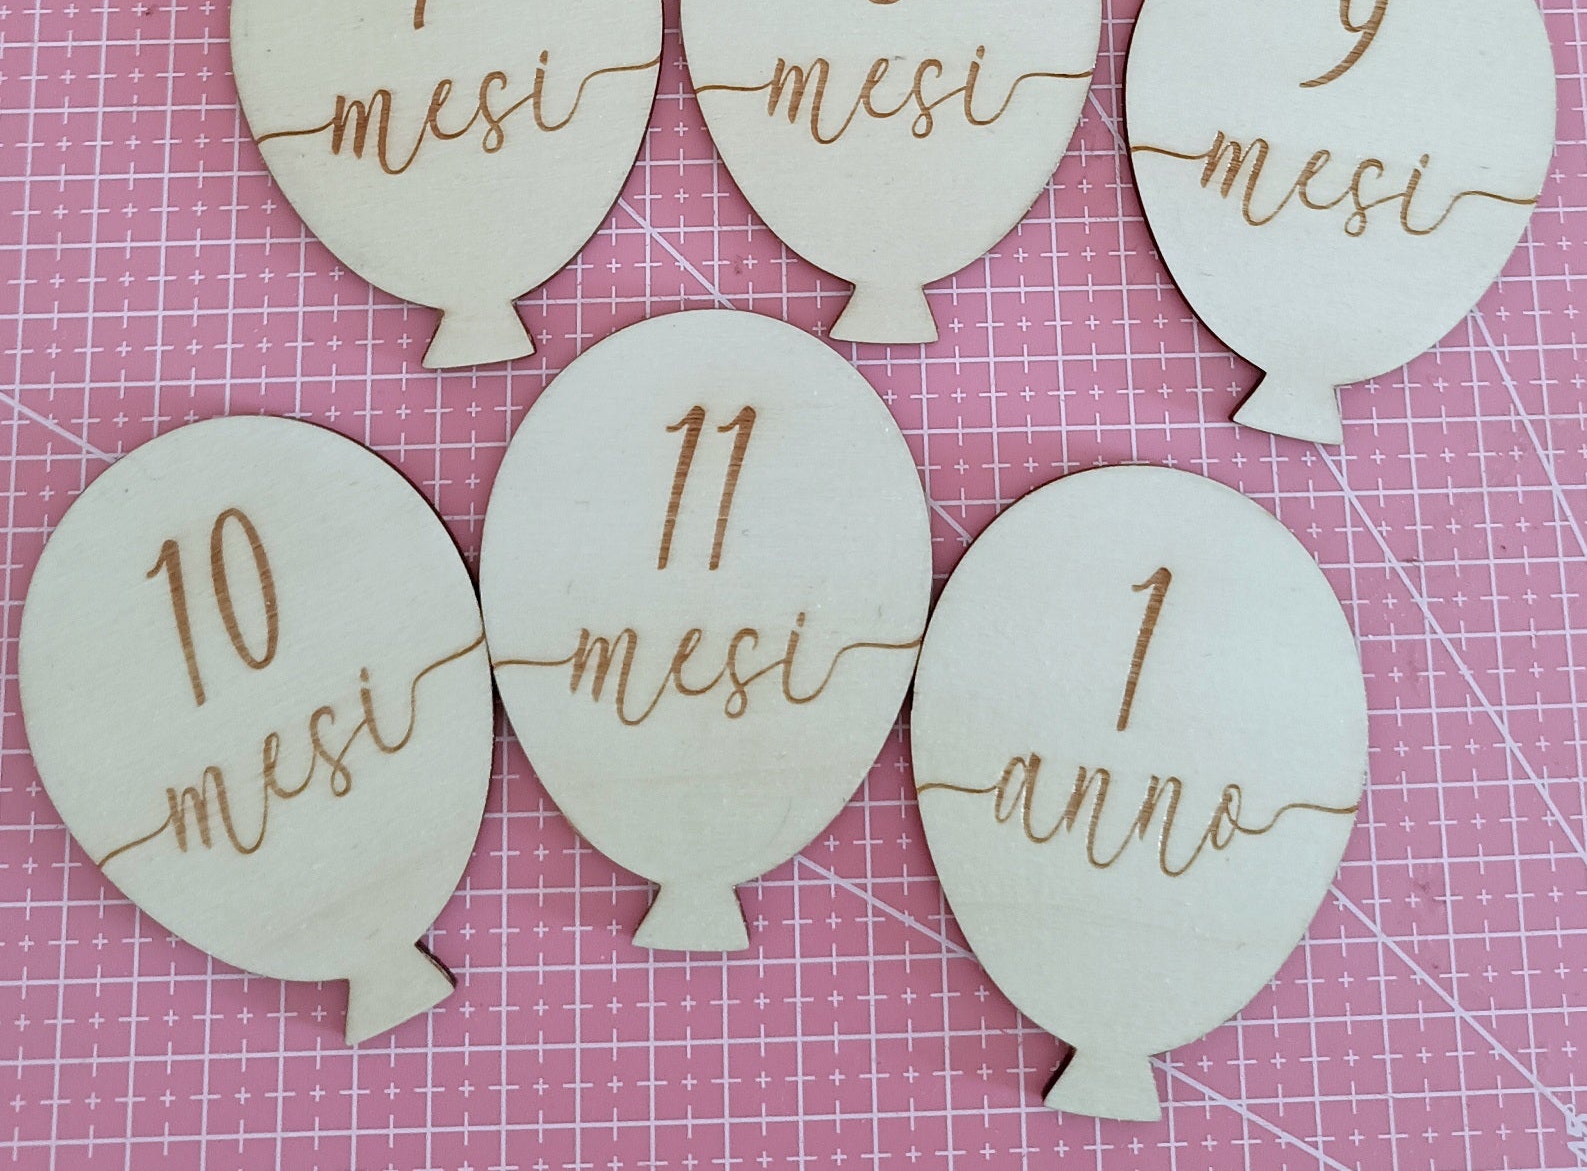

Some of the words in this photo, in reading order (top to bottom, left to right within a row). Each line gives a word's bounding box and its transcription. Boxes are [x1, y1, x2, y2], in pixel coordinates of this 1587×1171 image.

[330, 50, 584, 174] mesi
[769, 45, 1015, 145] mesi
[1201, 130, 1459, 237] mesi
[658, 405, 757, 571] 11
[147, 508, 278, 706] 10
[569, 612, 840, 726] mesi
[1117, 567, 1174, 732] 1
[164, 668, 416, 854] mesi
[993, 751, 1271, 877] anno
